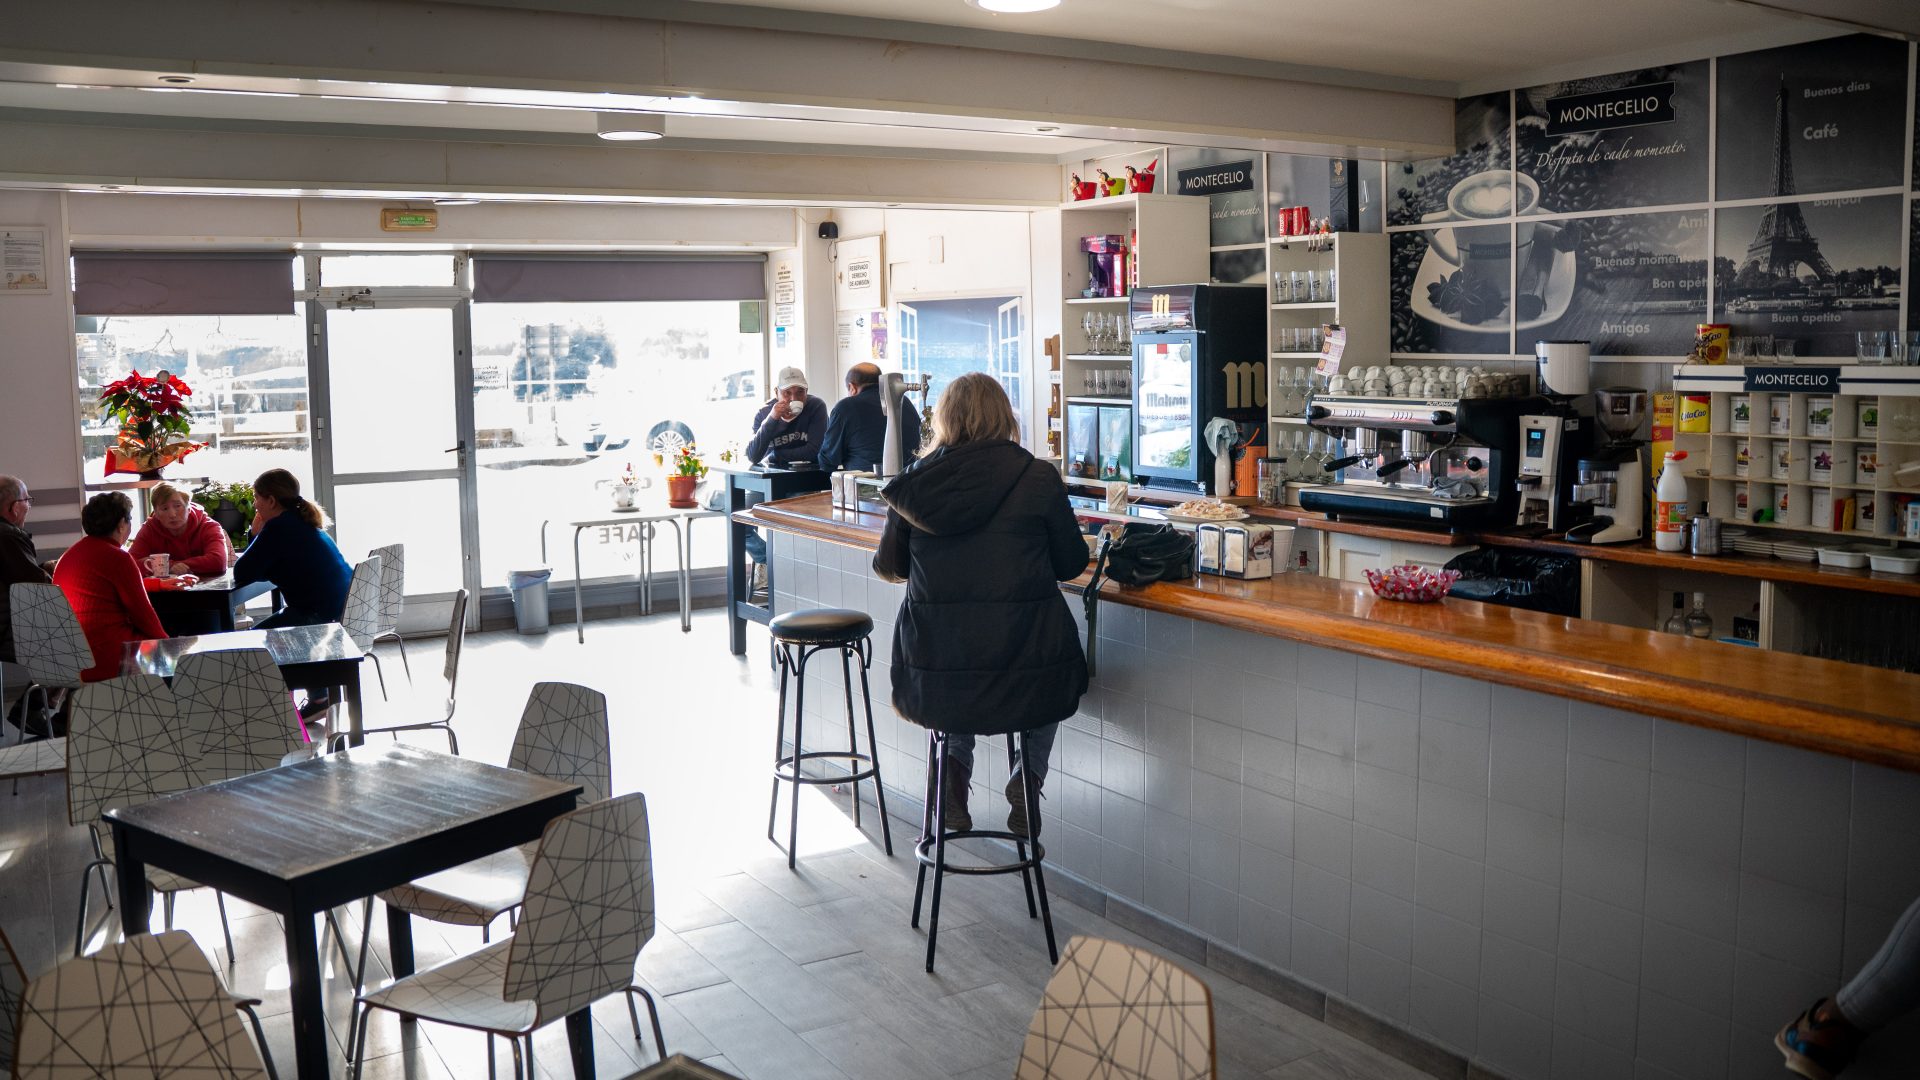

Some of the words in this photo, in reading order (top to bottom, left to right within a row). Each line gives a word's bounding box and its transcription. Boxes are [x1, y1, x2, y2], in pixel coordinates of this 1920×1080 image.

[1803, 86, 1843, 98] Buenos
[1560, 96, 1659, 124] MONTECELIO
[1803, 123, 1839, 140] Café
[1536, 144, 1585, 183] Disfruta
[1587, 140, 1604, 164] de
[1604, 137, 1632, 161] cada
[1185, 170, 1244, 189] MONTECELIO
[1595, 256, 1636, 268] Buenos
[1652, 278, 1675, 289] Bon
[1771, 313, 1799, 323] Buen
[1802, 313, 1842, 326] apetito
[1600, 320, 1651, 337] Amigos
[1754, 373, 1829, 386] MONTECELIO
